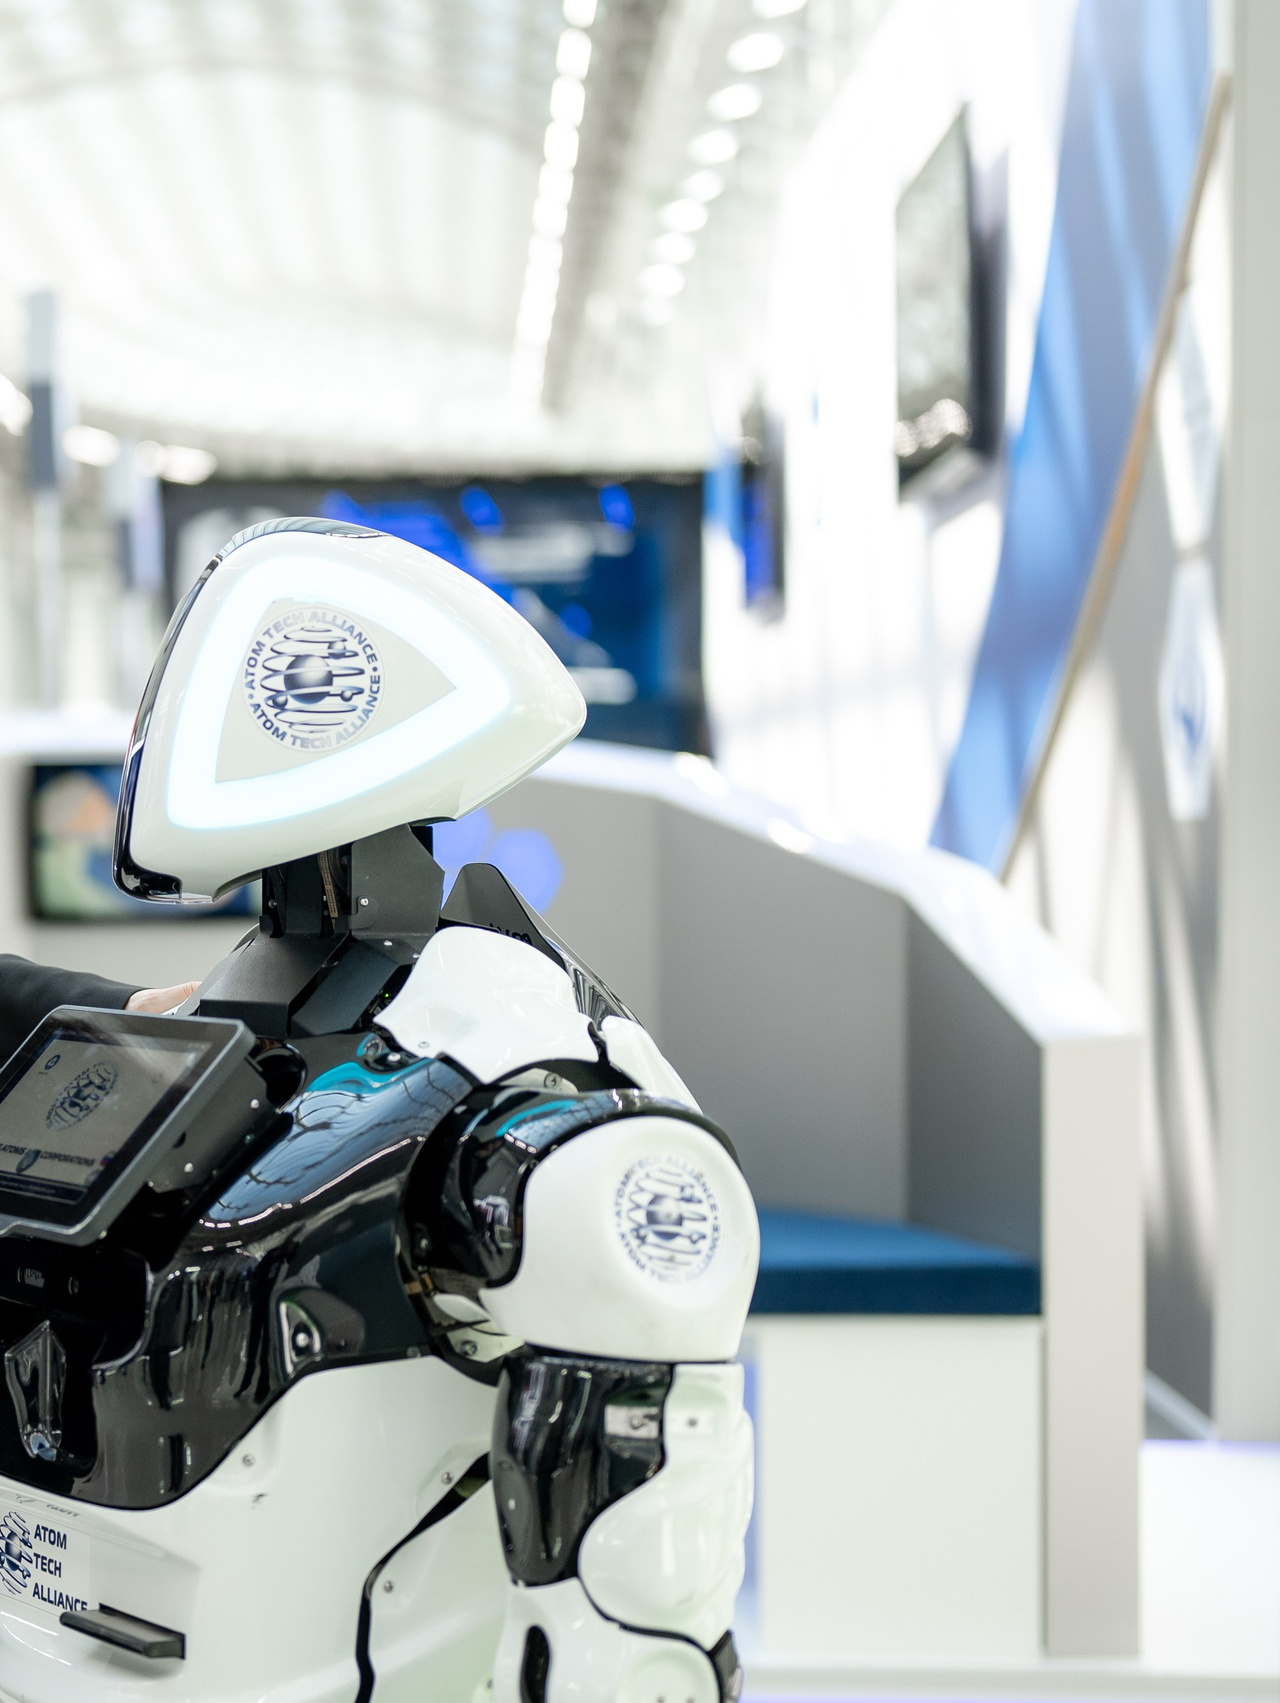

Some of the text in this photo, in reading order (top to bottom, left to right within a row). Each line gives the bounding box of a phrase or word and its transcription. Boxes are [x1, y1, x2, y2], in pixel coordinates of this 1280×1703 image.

[245, 611, 379, 690] ATOM TECH ALLIANCE
[250, 675, 380, 749] ATOM TECH ALLIANCE
[34, 1524, 67, 1550] ATOM
[33, 1552, 62, 1578] TECH
